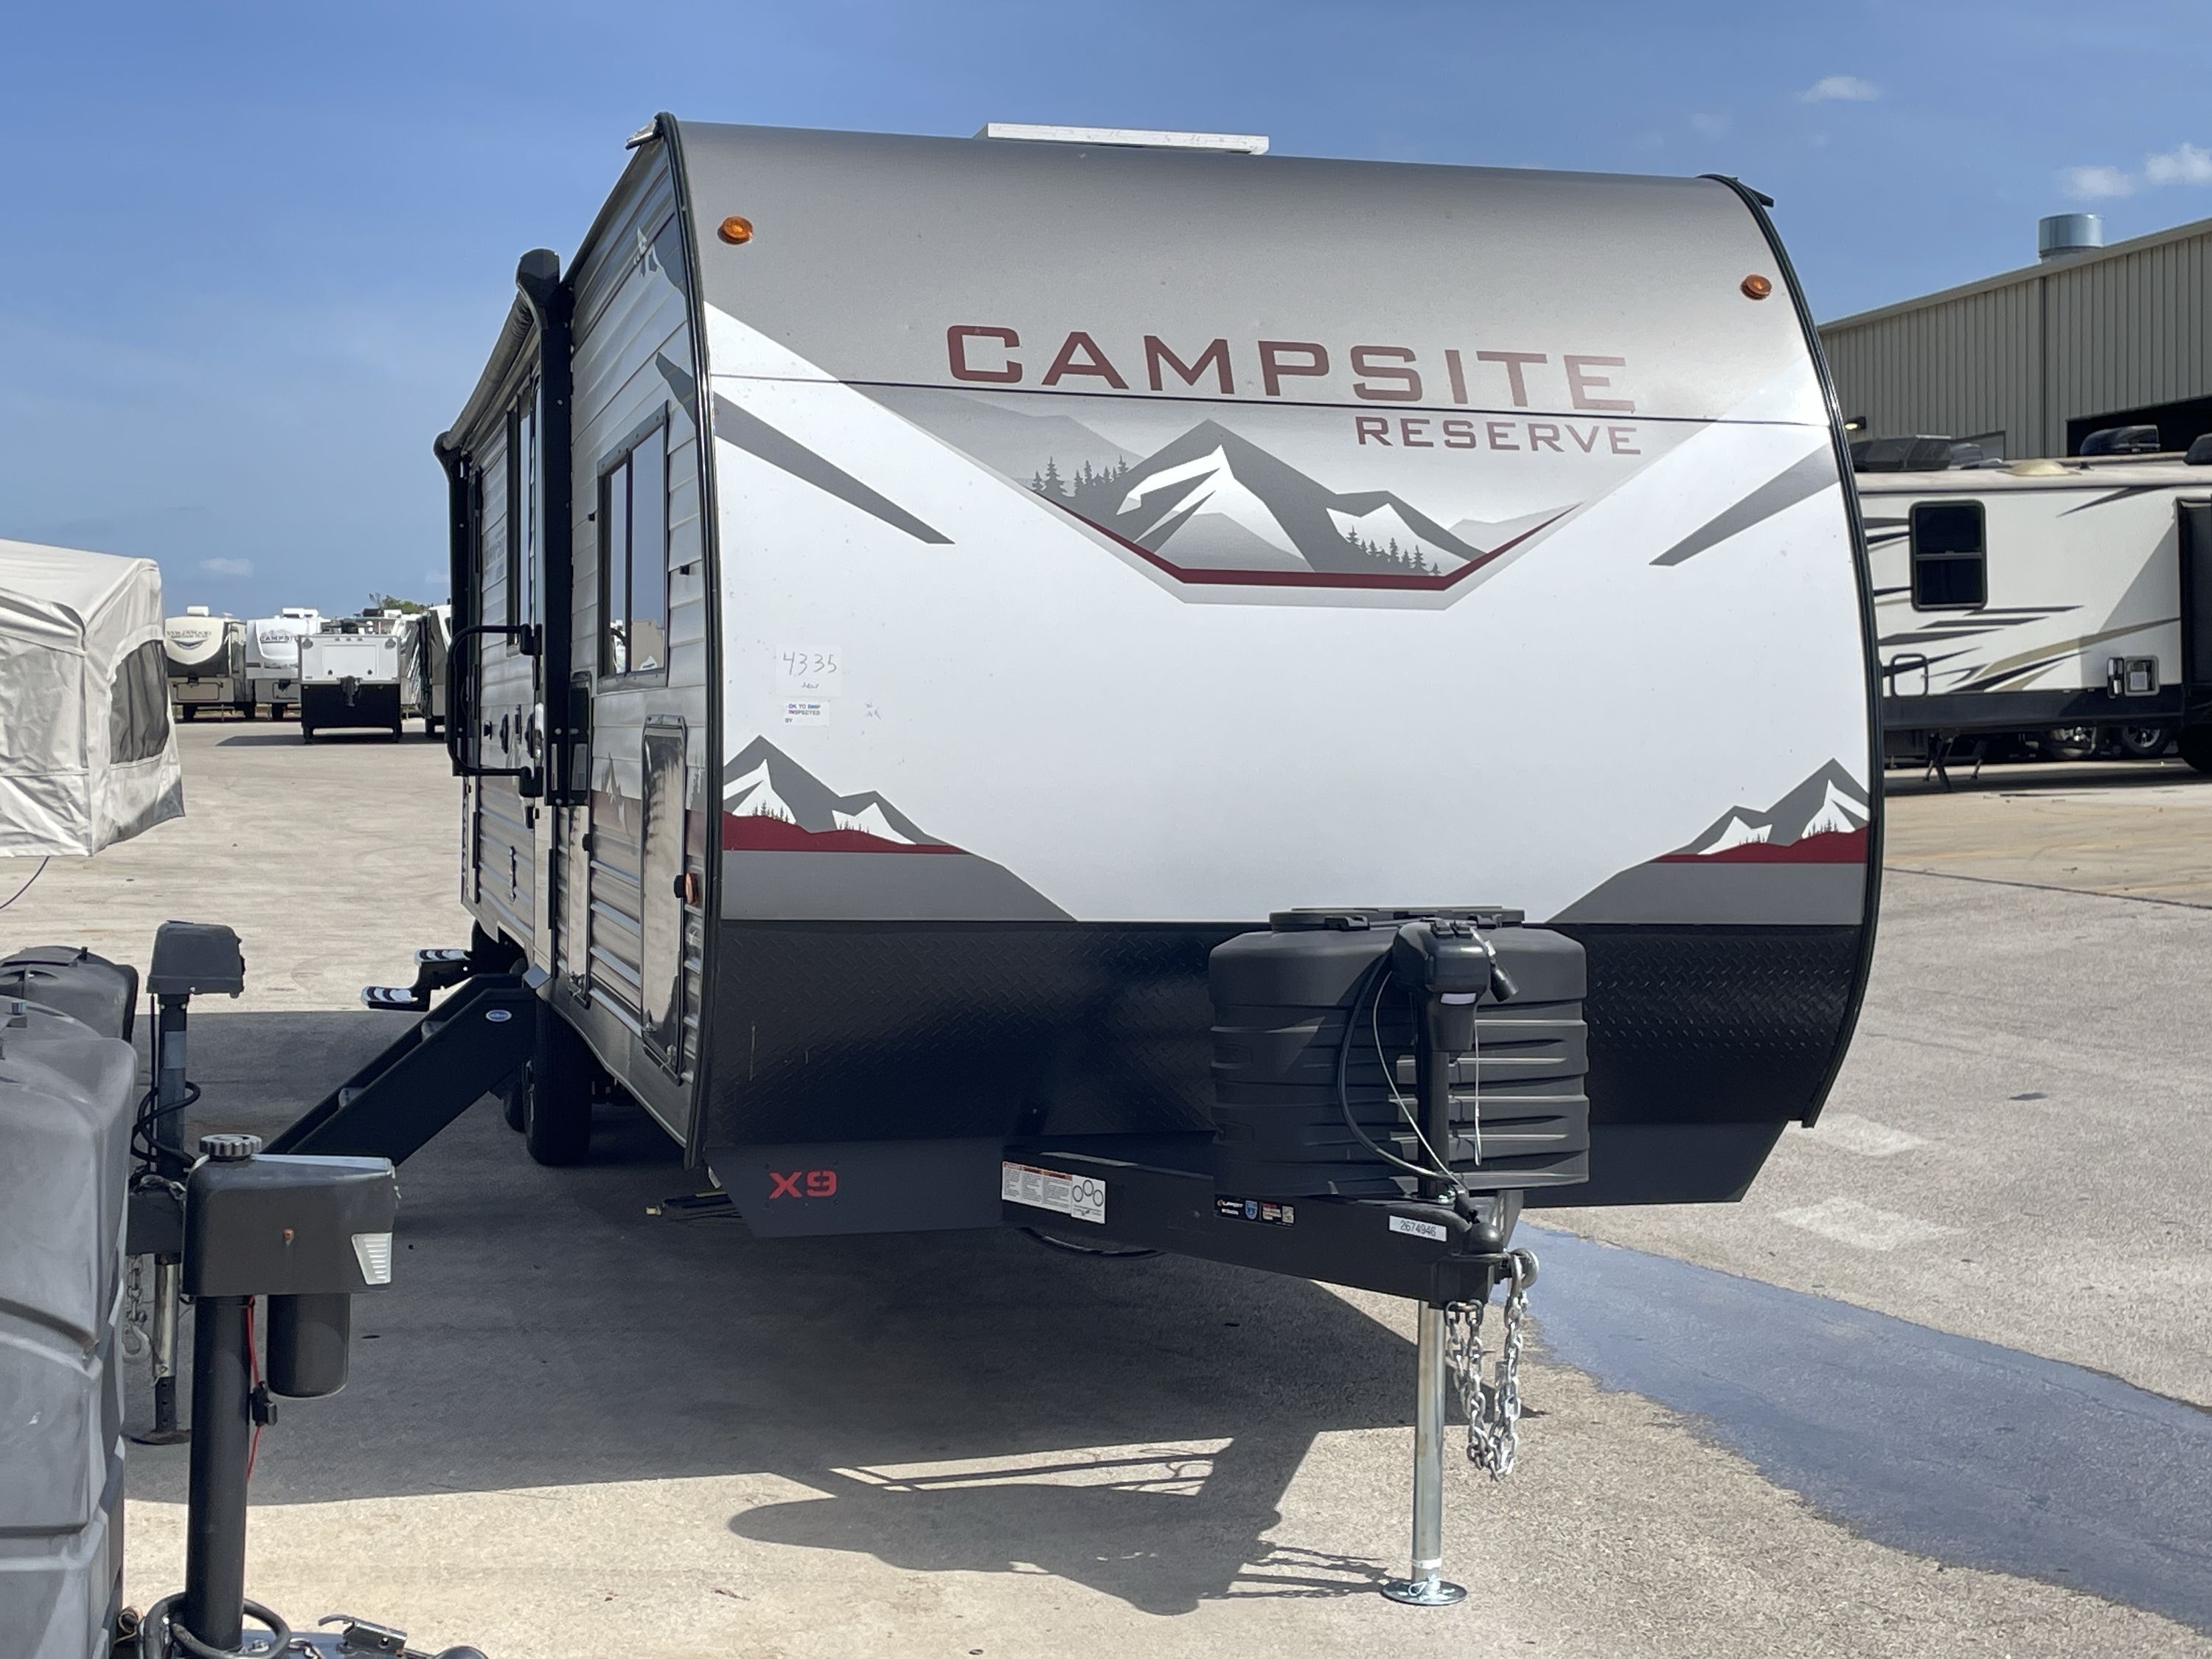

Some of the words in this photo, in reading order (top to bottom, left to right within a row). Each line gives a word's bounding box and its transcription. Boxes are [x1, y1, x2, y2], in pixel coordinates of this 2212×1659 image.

[947, 324, 1635, 412] CAMPSITE
[1354, 416, 1641, 455] RESERVE
[783, 651, 837, 676] 4335
[769, 1170, 837, 1200] X9
[1400, 1220, 1436, 1237] 2674946
